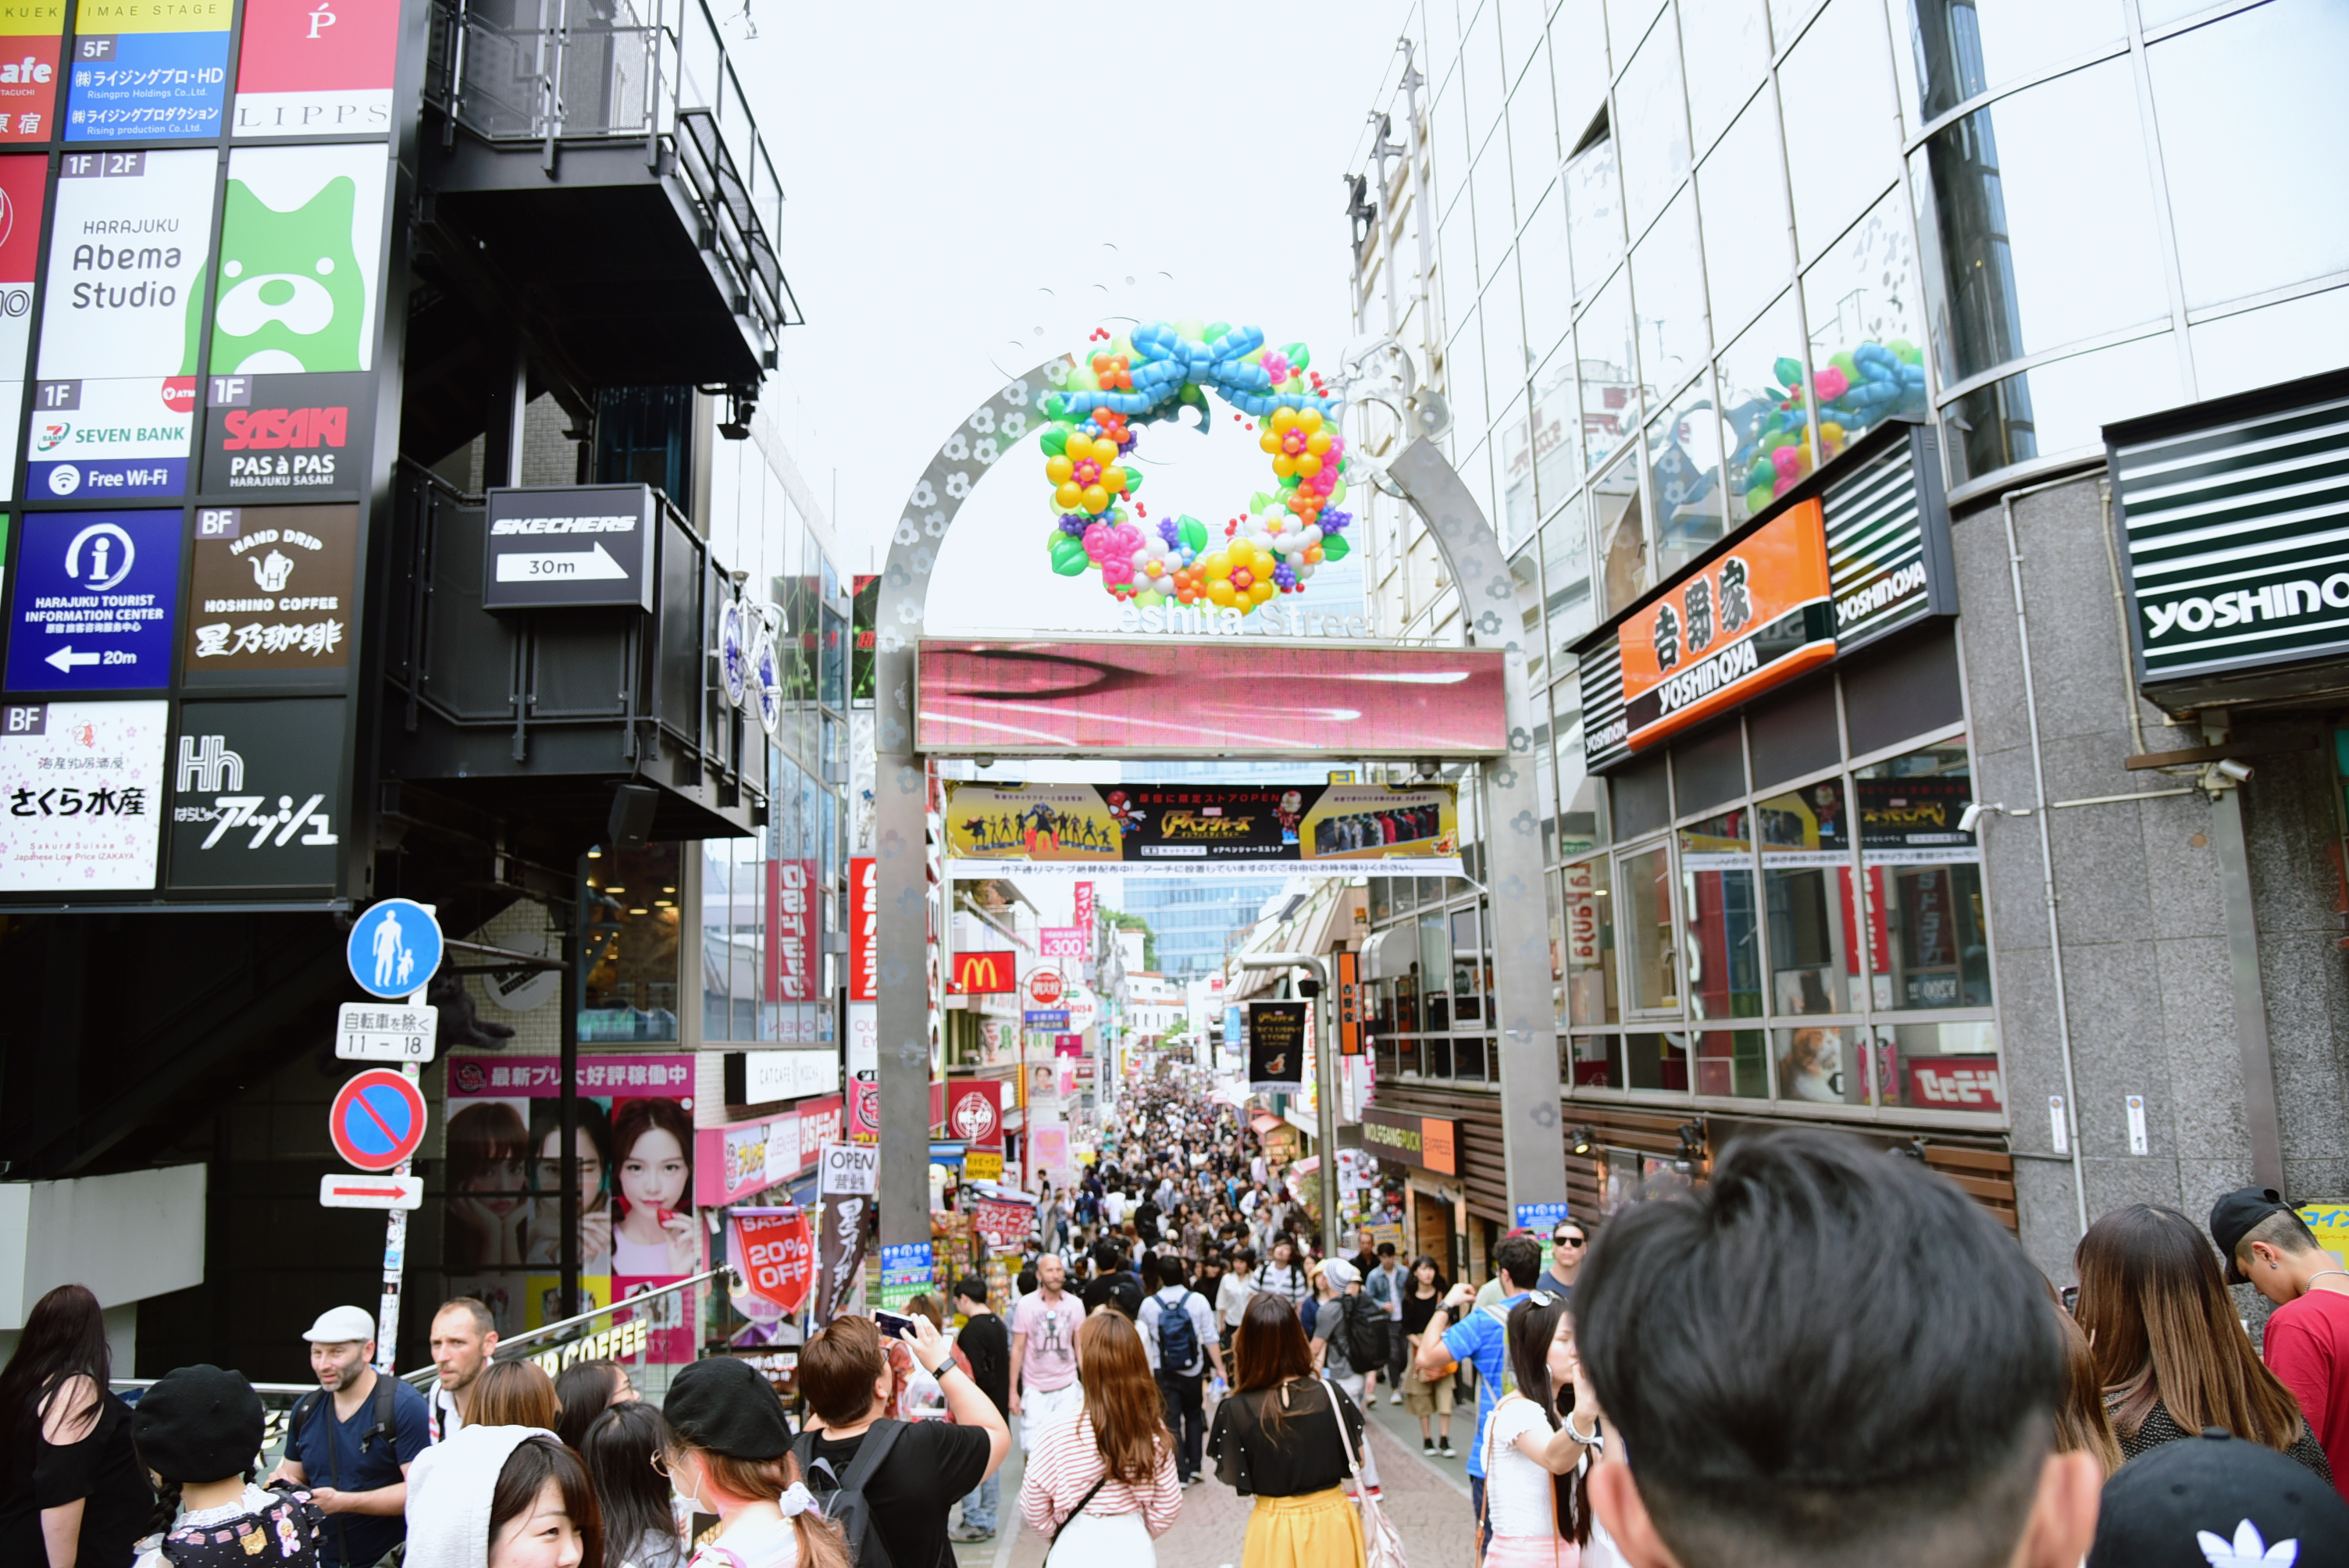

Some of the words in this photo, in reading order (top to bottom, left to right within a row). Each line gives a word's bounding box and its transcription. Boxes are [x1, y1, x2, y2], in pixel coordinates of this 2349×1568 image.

[87, 6, 138, 17] IMAE
[152, 3, 217, 16] STAGE
[83, 41, 110, 57] 5F
[0, 56, 52, 84] afe
[87, 90, 130, 100] Risingpro
[133, 87, 171, 99] Holdings
[237, 104, 387, 127] LIPPS
[87, 126, 114, 136] Rising
[117, 124, 166, 136] production
[70, 155, 91, 174] 1F
[110, 154, 137, 173] 2F
[84, 218, 180, 235] HARAJUKU
[73, 244, 182, 271] Abema
[73, 281, 176, 309] Studio
[45, 385, 70, 407] 1F
[214, 379, 245, 403] 1F
[76, 429, 131, 444] SEVEN
[137, 426, 185, 442] BANK
[223, 406, 348, 451] SASAKI
[232, 457, 273, 476] PAS
[278, 455, 290, 475] à
[293, 454, 335, 473] PAS
[88, 471, 124, 487] Free
[127, 469, 168, 486] Wi-Fi
[230, 476, 290, 487] HARAJUKU
[293, 475, 334, 486] SASAKI
[201, 511, 233, 534] BF
[490, 515, 638, 536] SKECHERS
[230, 529, 279, 555] HAND
[283, 529, 323, 551] DRIP
[529, 559, 576, 575] 30m
[35, 596, 99, 608] HARAJUKU
[102, 594, 155, 607] TOURIST
[1836, 559, 1927, 627] YOSHINOYA
[25, 609, 113, 622] INFORMATION
[116, 608, 164, 621] CENTER
[205, 598, 275, 613] HOSHINO
[279, 597, 339, 611] COFFEE
[1653, 555, 1752, 675] 吉野家
[195, 618, 344, 657] 星乃珈琲
[103, 651, 137, 665] 20m
[1658, 638, 1759, 715] YOSHINOYA
[9, 707, 41, 732] BF
[10, 786, 146, 817] さくら水産
[30, 842, 71, 850] Sakura
[344, 1013, 430, 1034] 自転車を除く
[348, 1035, 366, 1053] 11
[405, 1037, 422, 1055] 18
[831, 1151, 874, 1171] OPEN
[748, 1236, 809, 1267] 20%
[757, 1259, 808, 1288] OFF
